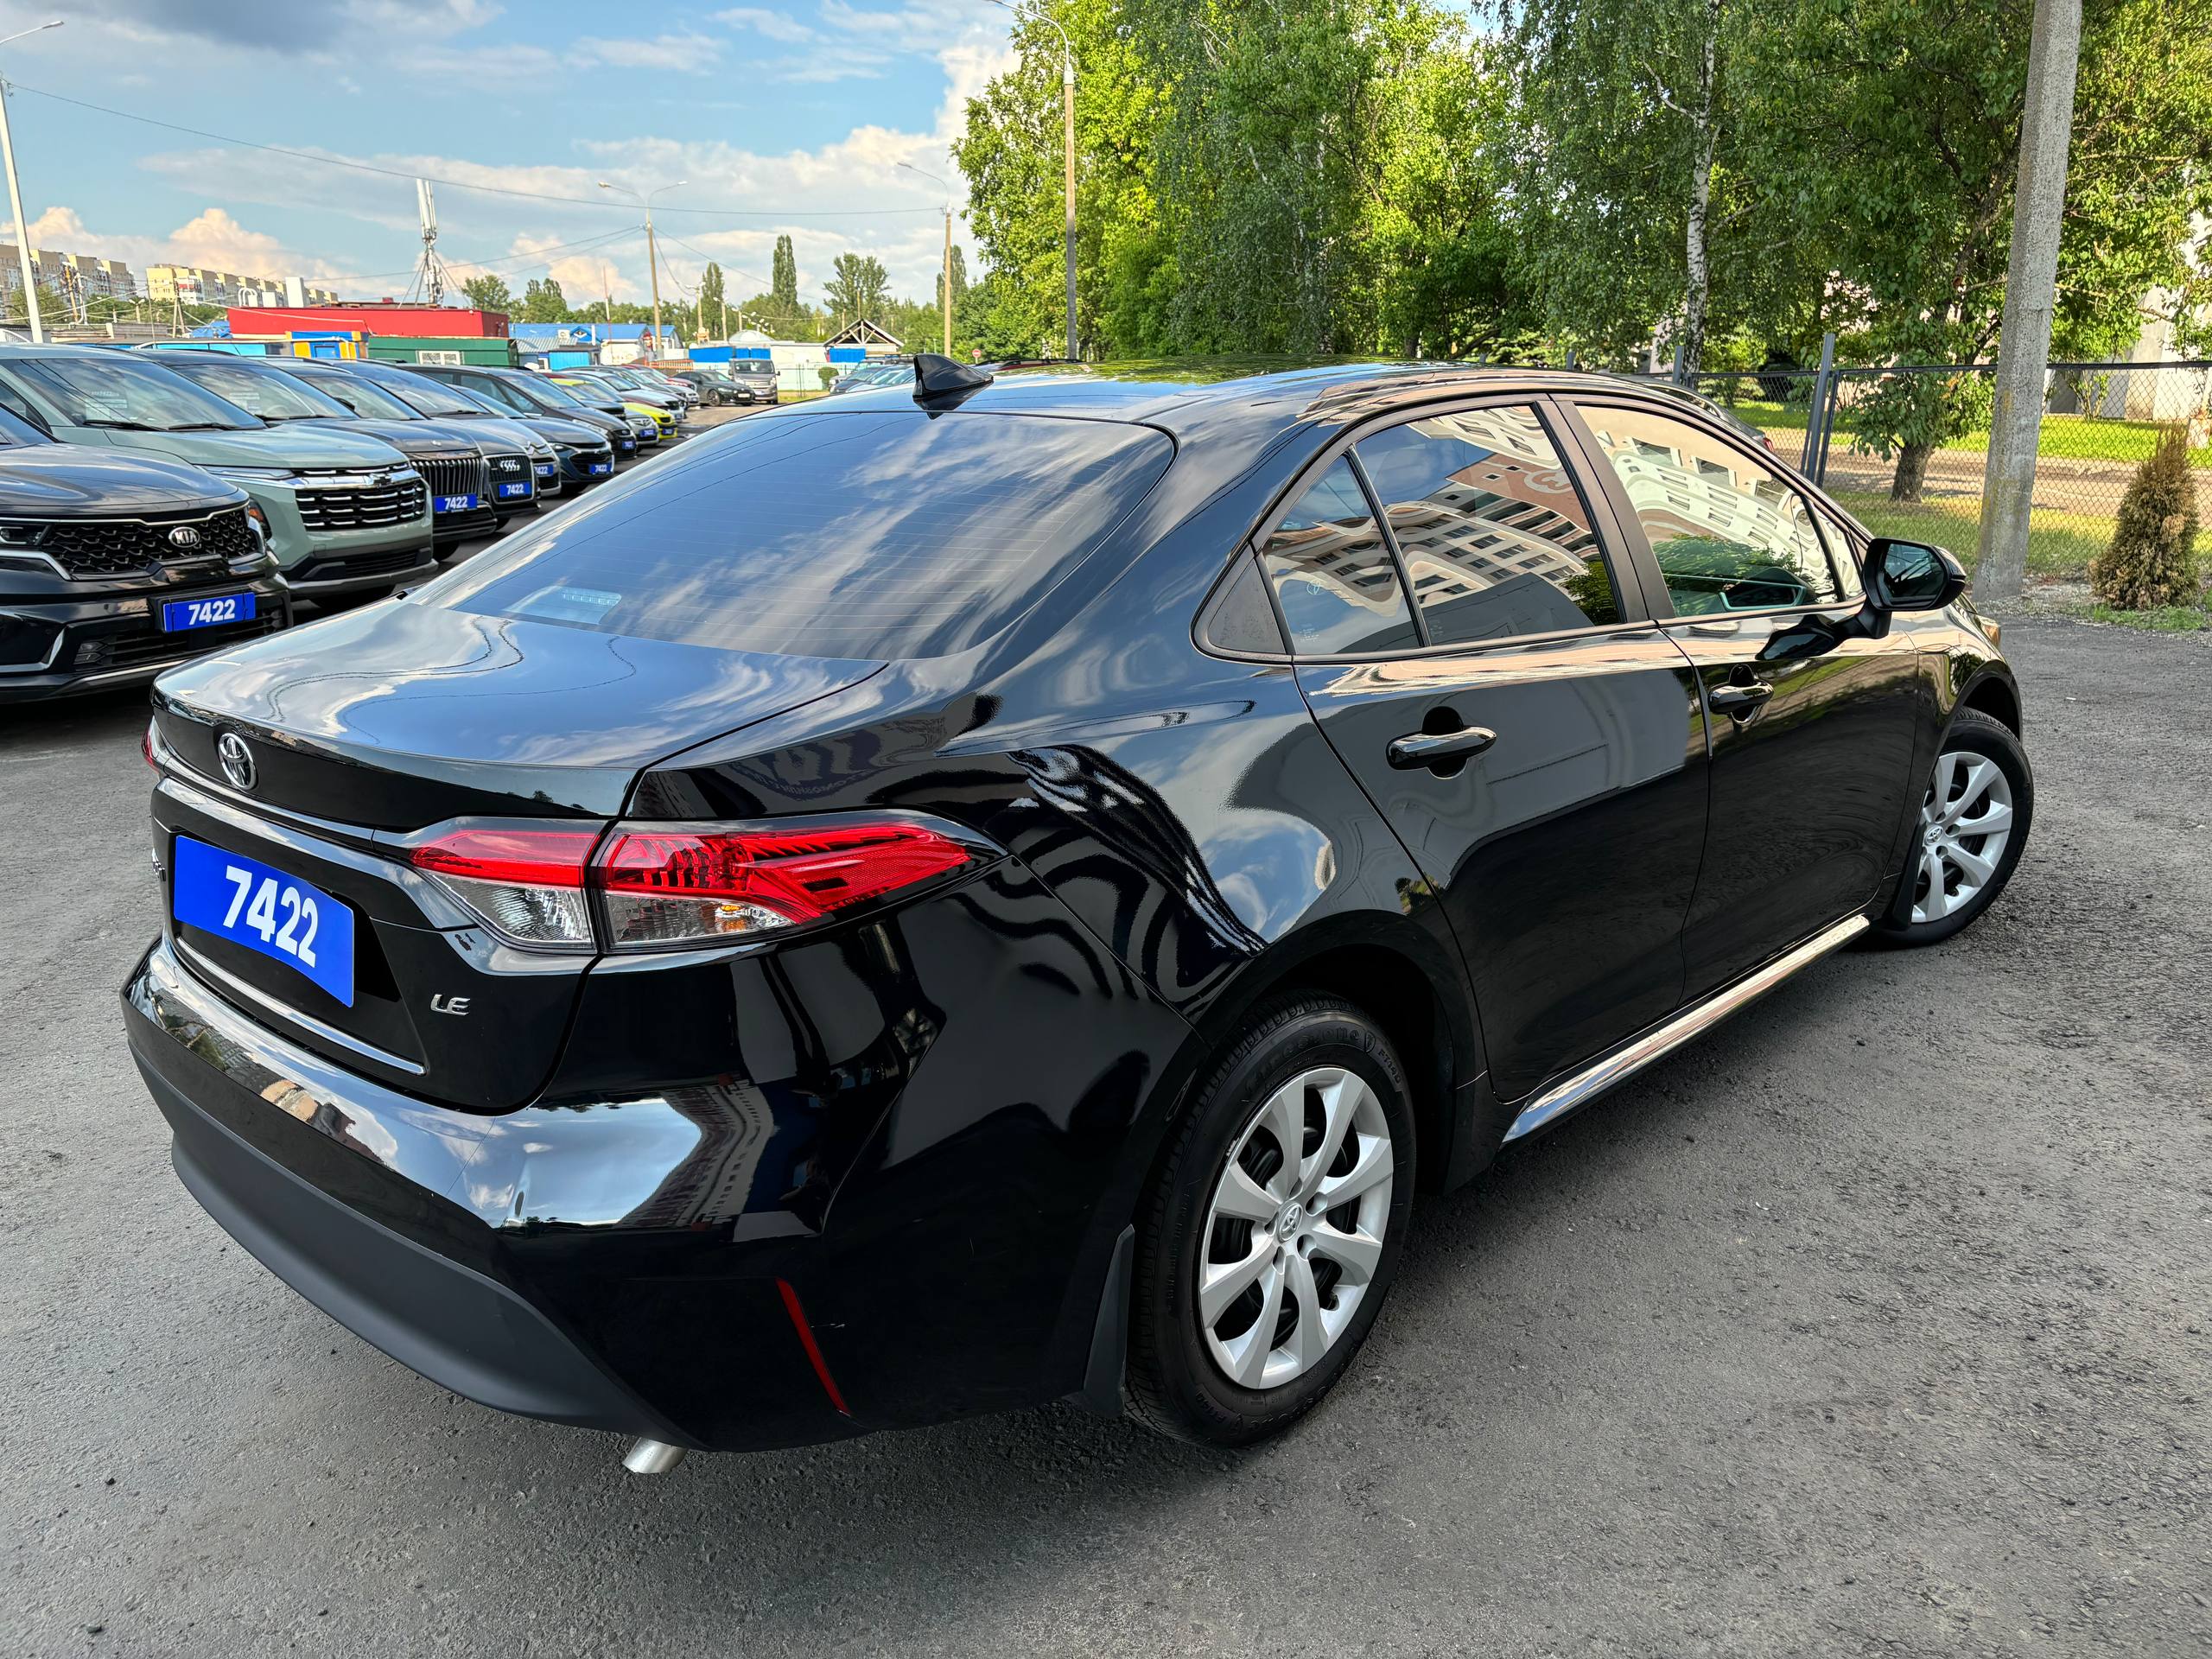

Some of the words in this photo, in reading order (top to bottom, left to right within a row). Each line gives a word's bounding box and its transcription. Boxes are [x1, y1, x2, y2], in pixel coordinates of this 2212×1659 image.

[506, 484, 524, 494] 7422
[445, 495, 467, 510] 7422
[175, 530, 197, 544] KIA
[188, 599, 235, 626] 7422
[222, 866, 319, 969] 7422
[429, 993, 470, 1016] LE
